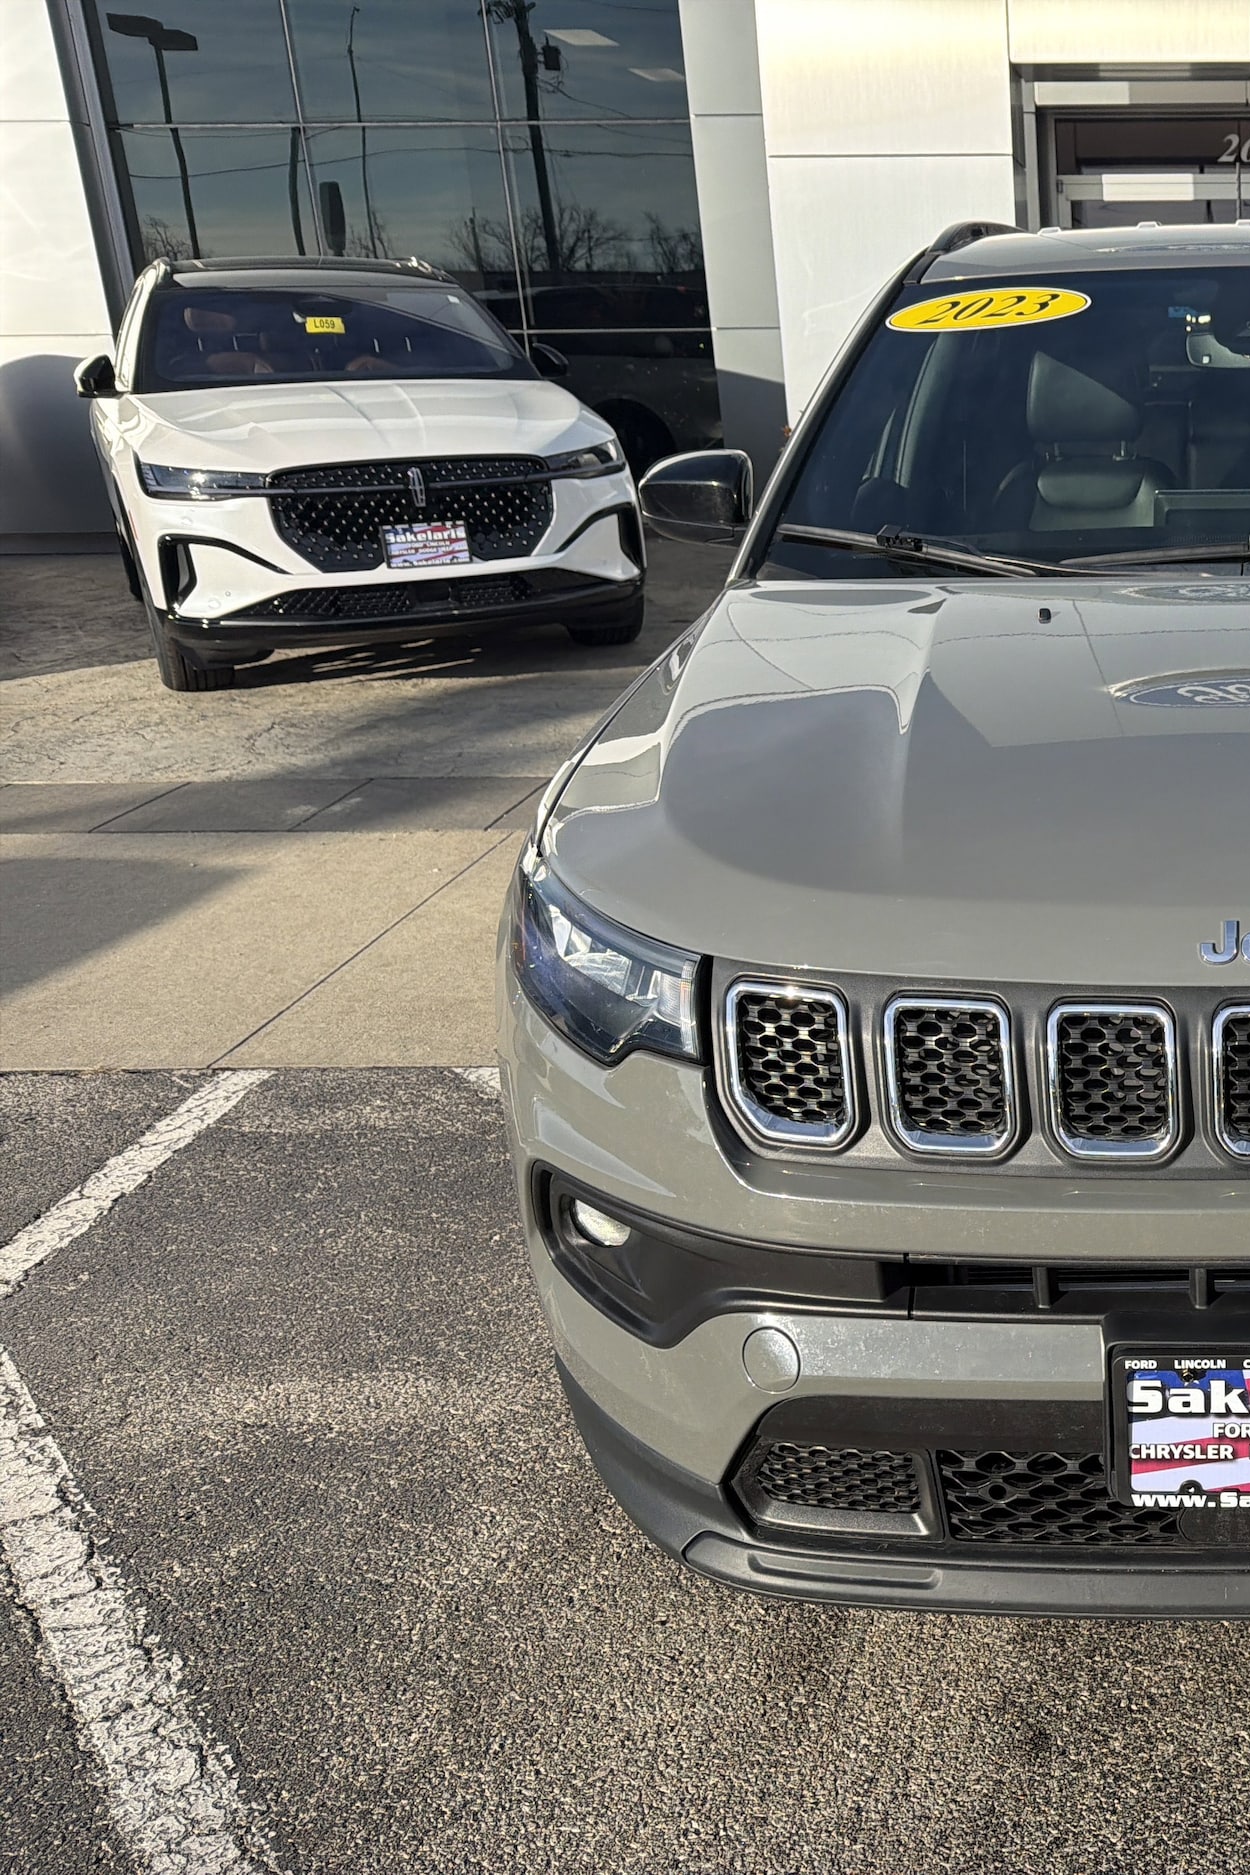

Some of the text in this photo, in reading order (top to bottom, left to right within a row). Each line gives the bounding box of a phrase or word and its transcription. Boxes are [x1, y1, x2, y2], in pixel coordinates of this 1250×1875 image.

[914, 293, 1061, 326] 2023
[313, 319, 336, 329] L059
[1124, 1359, 1158, 1370] FORD
[1174, 1359, 1227, 1370] LINCOLN
[1129, 1444, 1234, 1460] CHRYSLER
